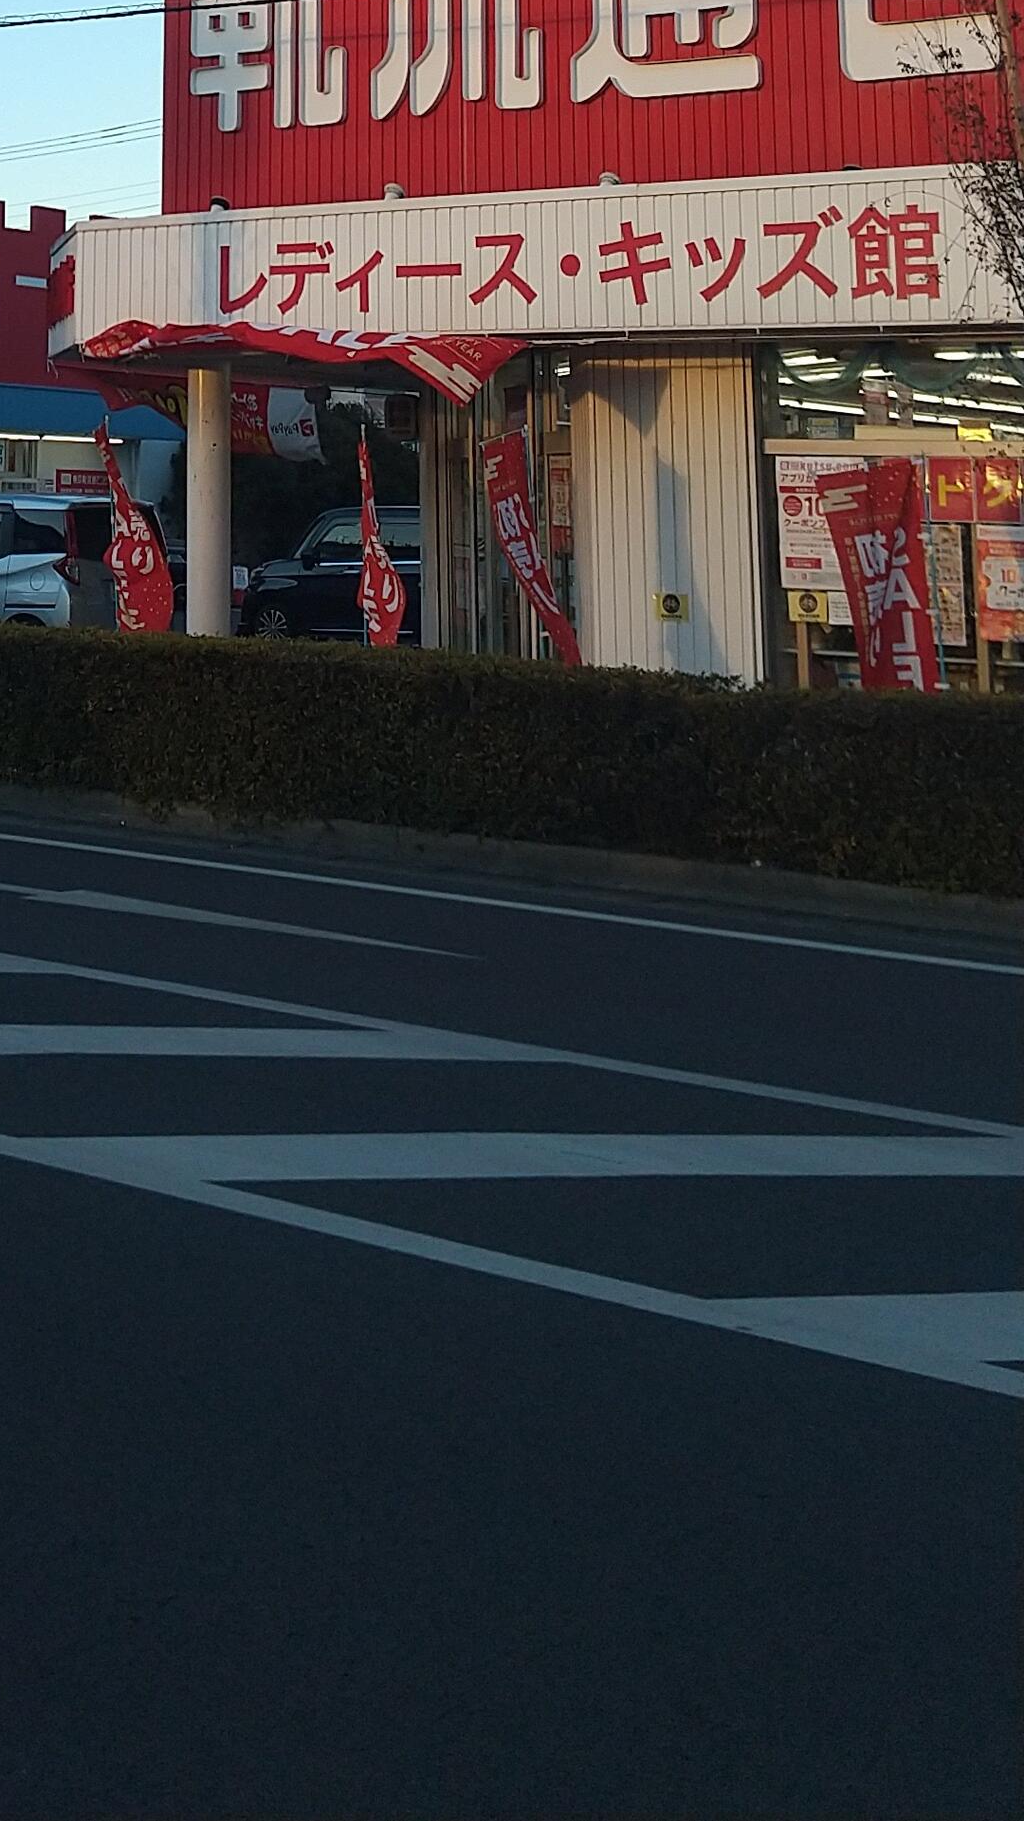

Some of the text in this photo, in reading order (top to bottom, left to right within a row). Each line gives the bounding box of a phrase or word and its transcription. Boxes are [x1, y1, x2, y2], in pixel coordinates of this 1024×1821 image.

[219, 203, 942, 316] レディース・キッズ館
